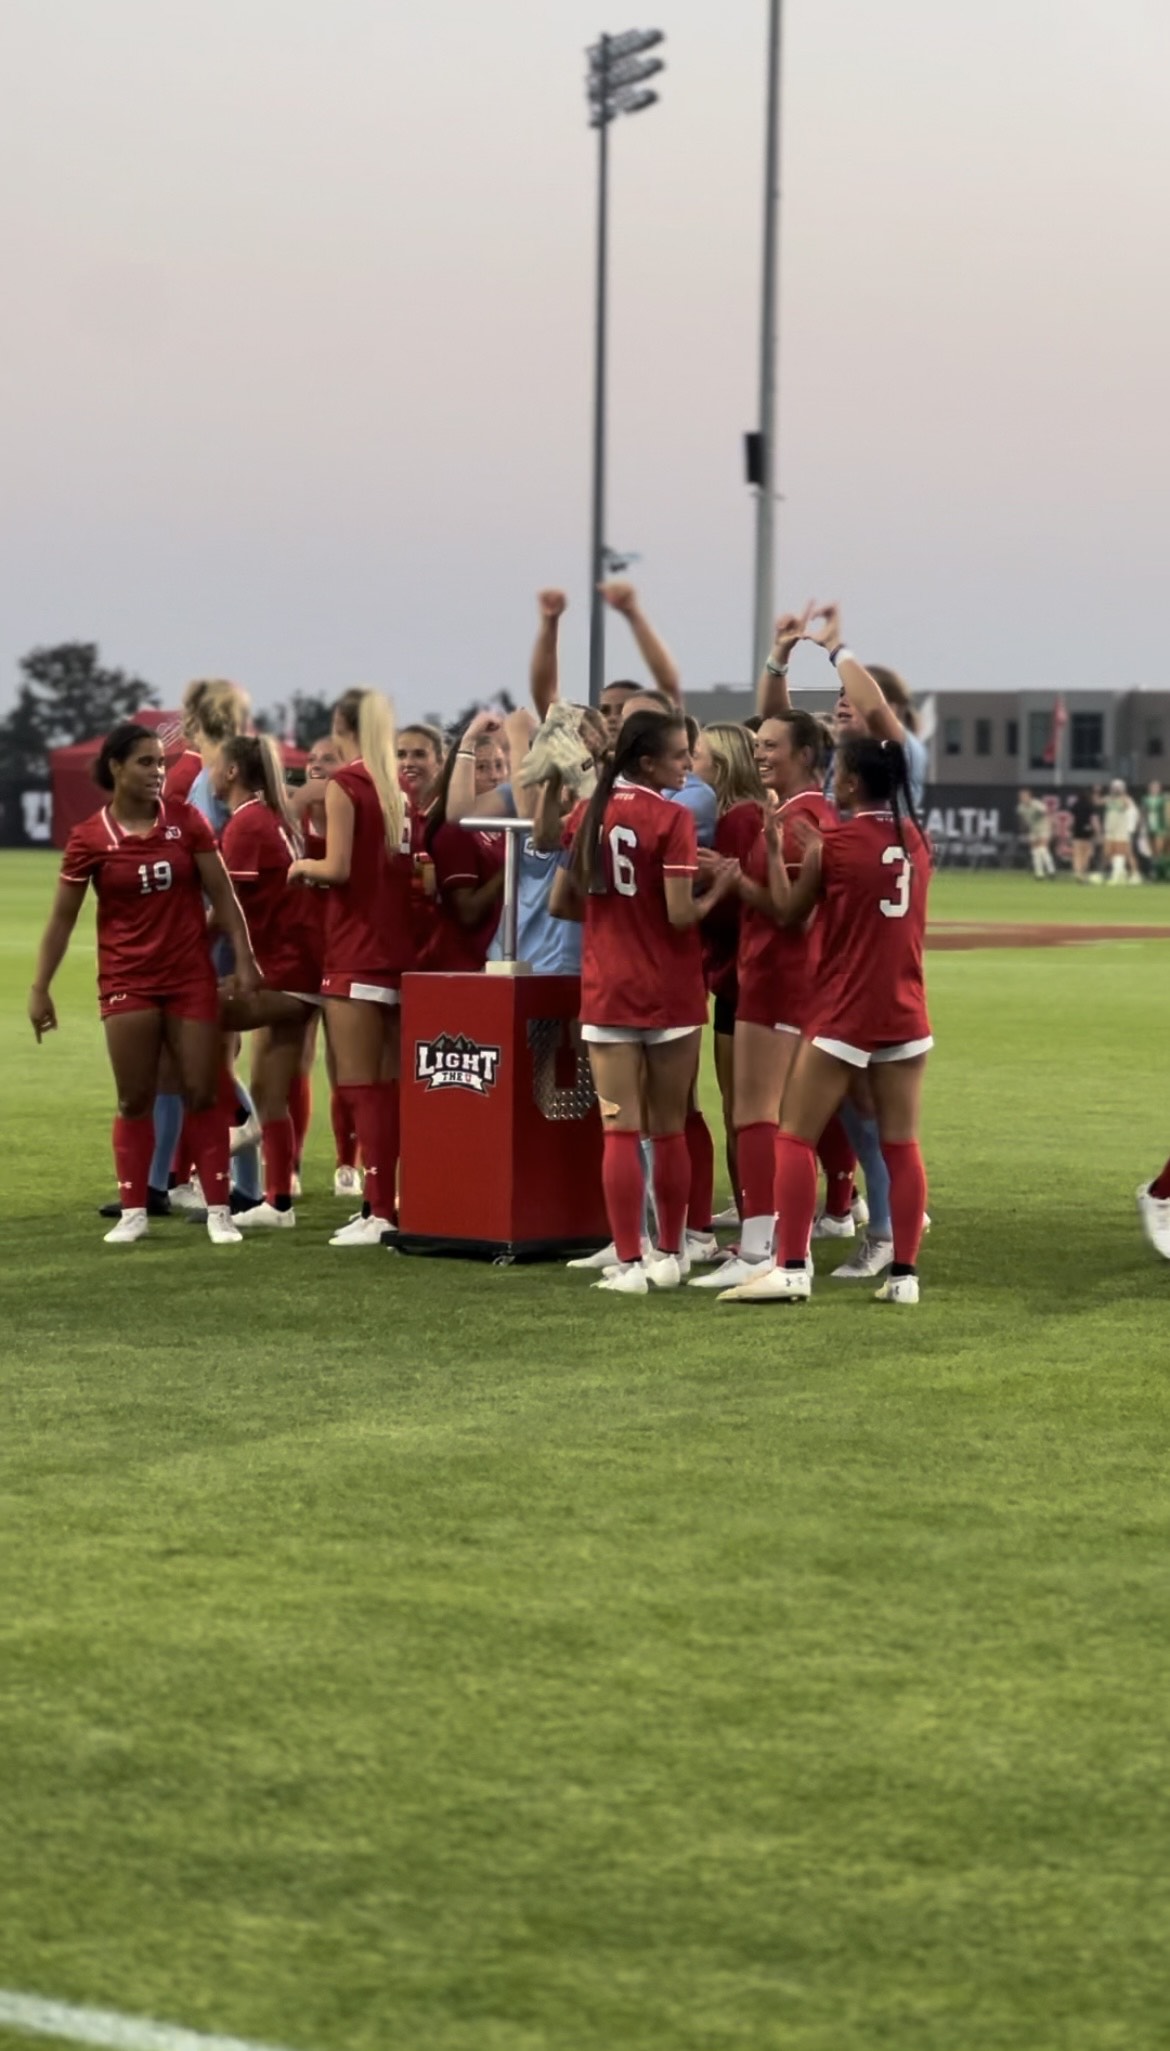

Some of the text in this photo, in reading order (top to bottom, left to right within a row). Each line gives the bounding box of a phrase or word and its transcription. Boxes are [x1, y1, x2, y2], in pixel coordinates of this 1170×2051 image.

[913, 807, 1000, 838] ALTH
[138, 860, 173, 895] 19
[879, 846, 911, 918] 3
[418, 1046, 497, 1080] LIGHT
[442, 1072, 472, 1083] THE U
